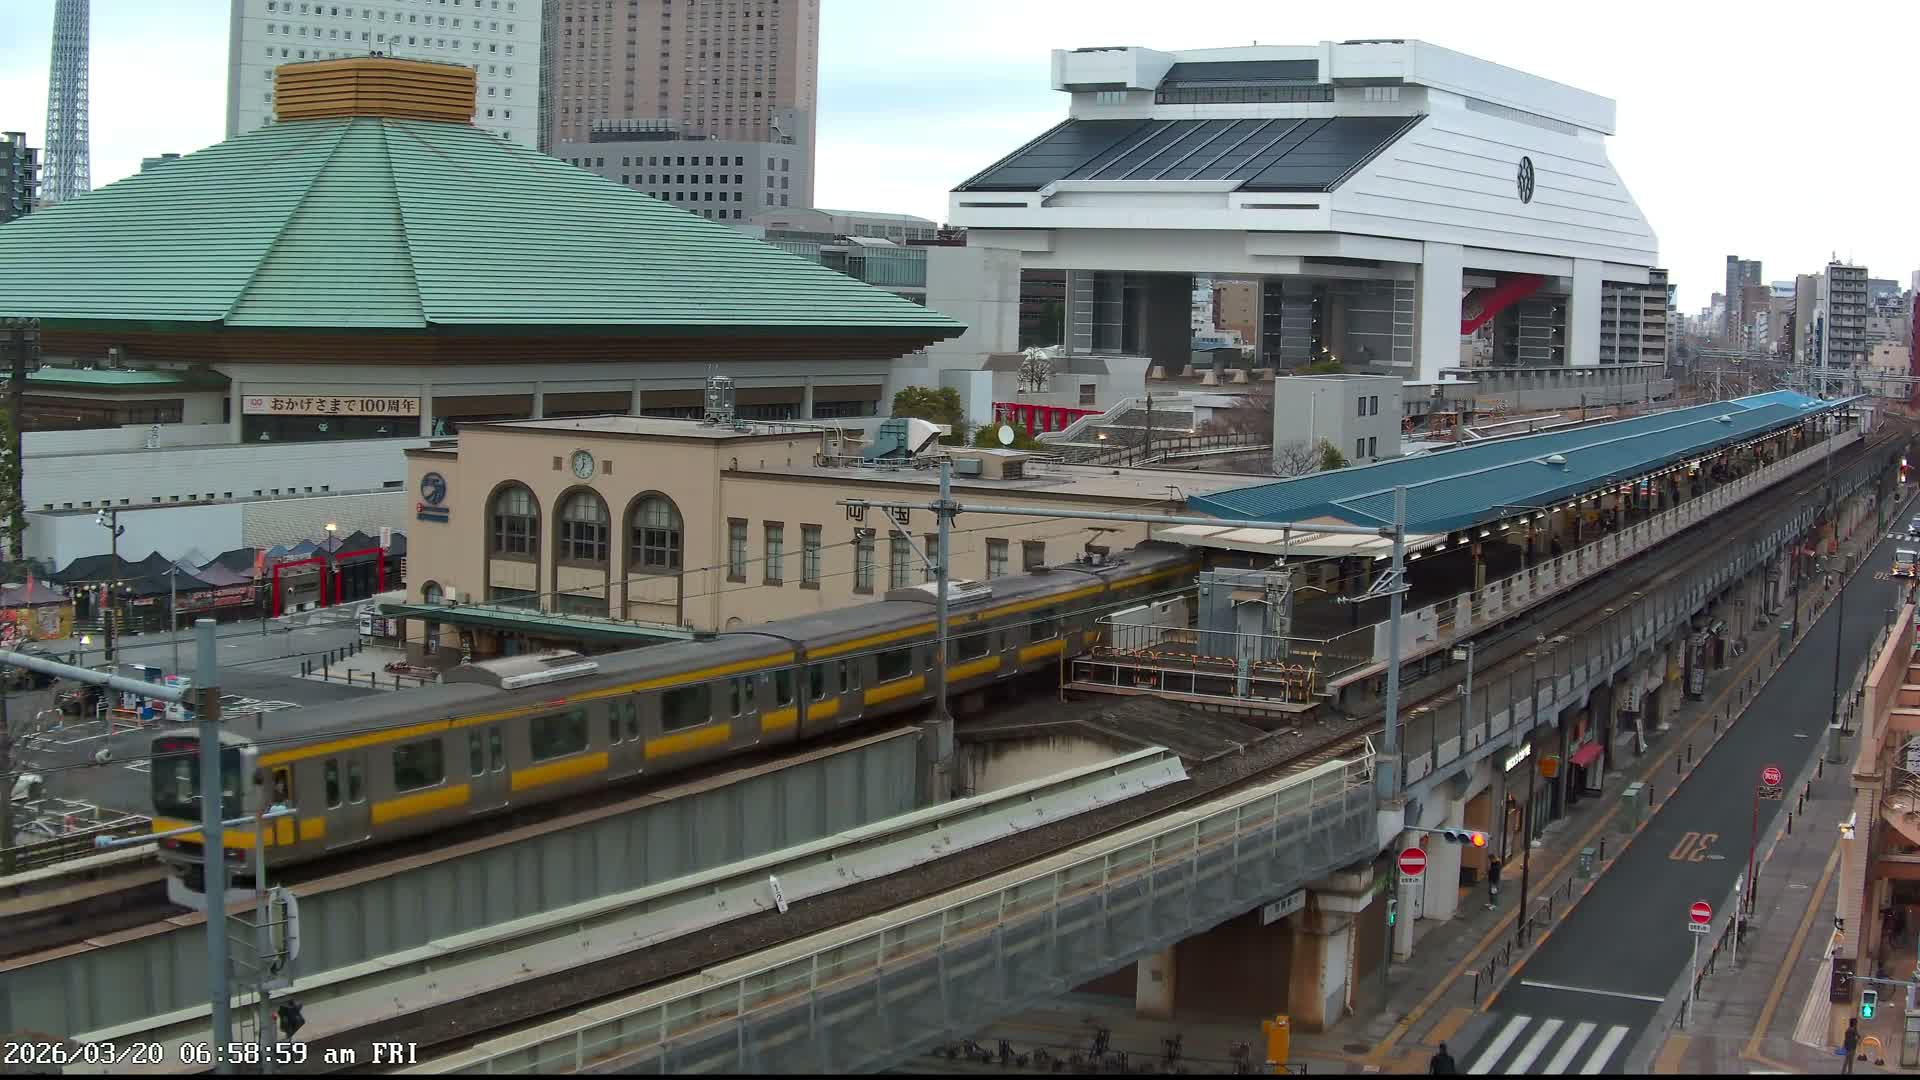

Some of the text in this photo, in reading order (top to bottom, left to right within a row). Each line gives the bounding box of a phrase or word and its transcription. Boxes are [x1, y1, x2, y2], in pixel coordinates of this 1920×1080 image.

[271, 398, 416, 413] おかげさまで100周年
